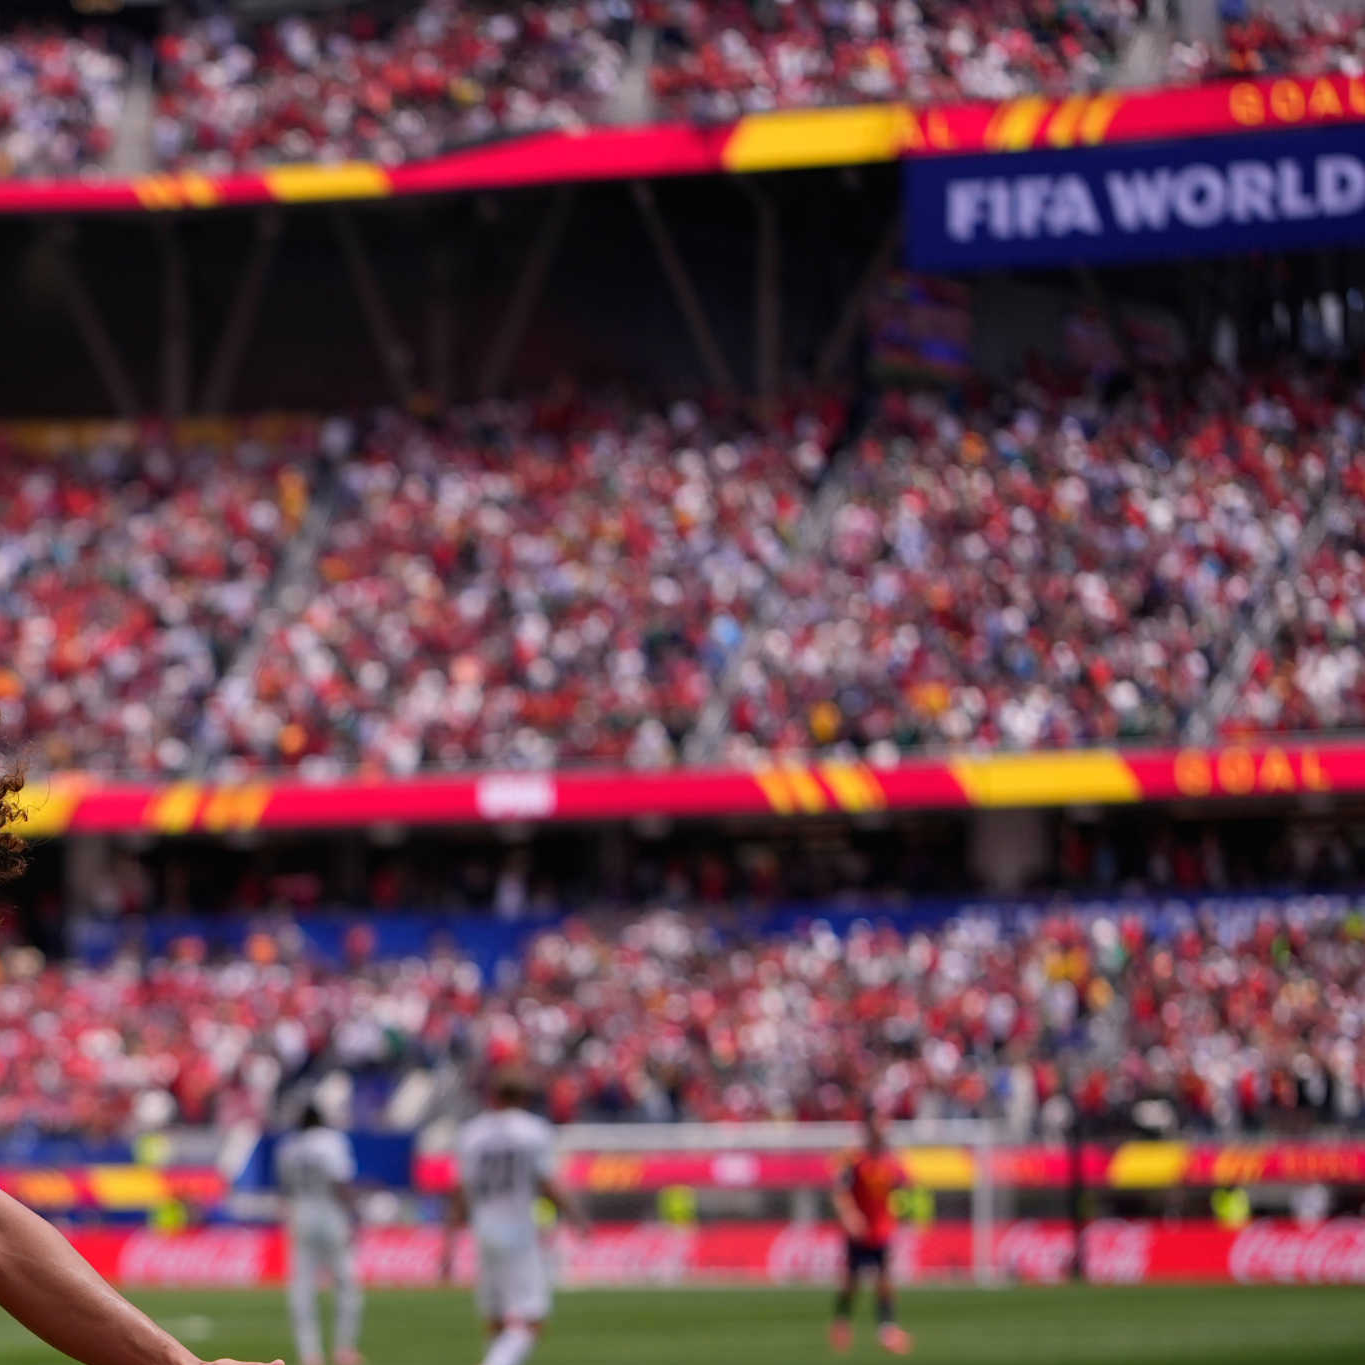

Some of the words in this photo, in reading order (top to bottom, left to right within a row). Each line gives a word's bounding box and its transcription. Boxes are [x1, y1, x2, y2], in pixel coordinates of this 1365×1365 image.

[946, 176, 1102, 243] FIFA
[1104, 155, 1365, 235] WORLD
[1174, 745, 1332, 797] GOAL
